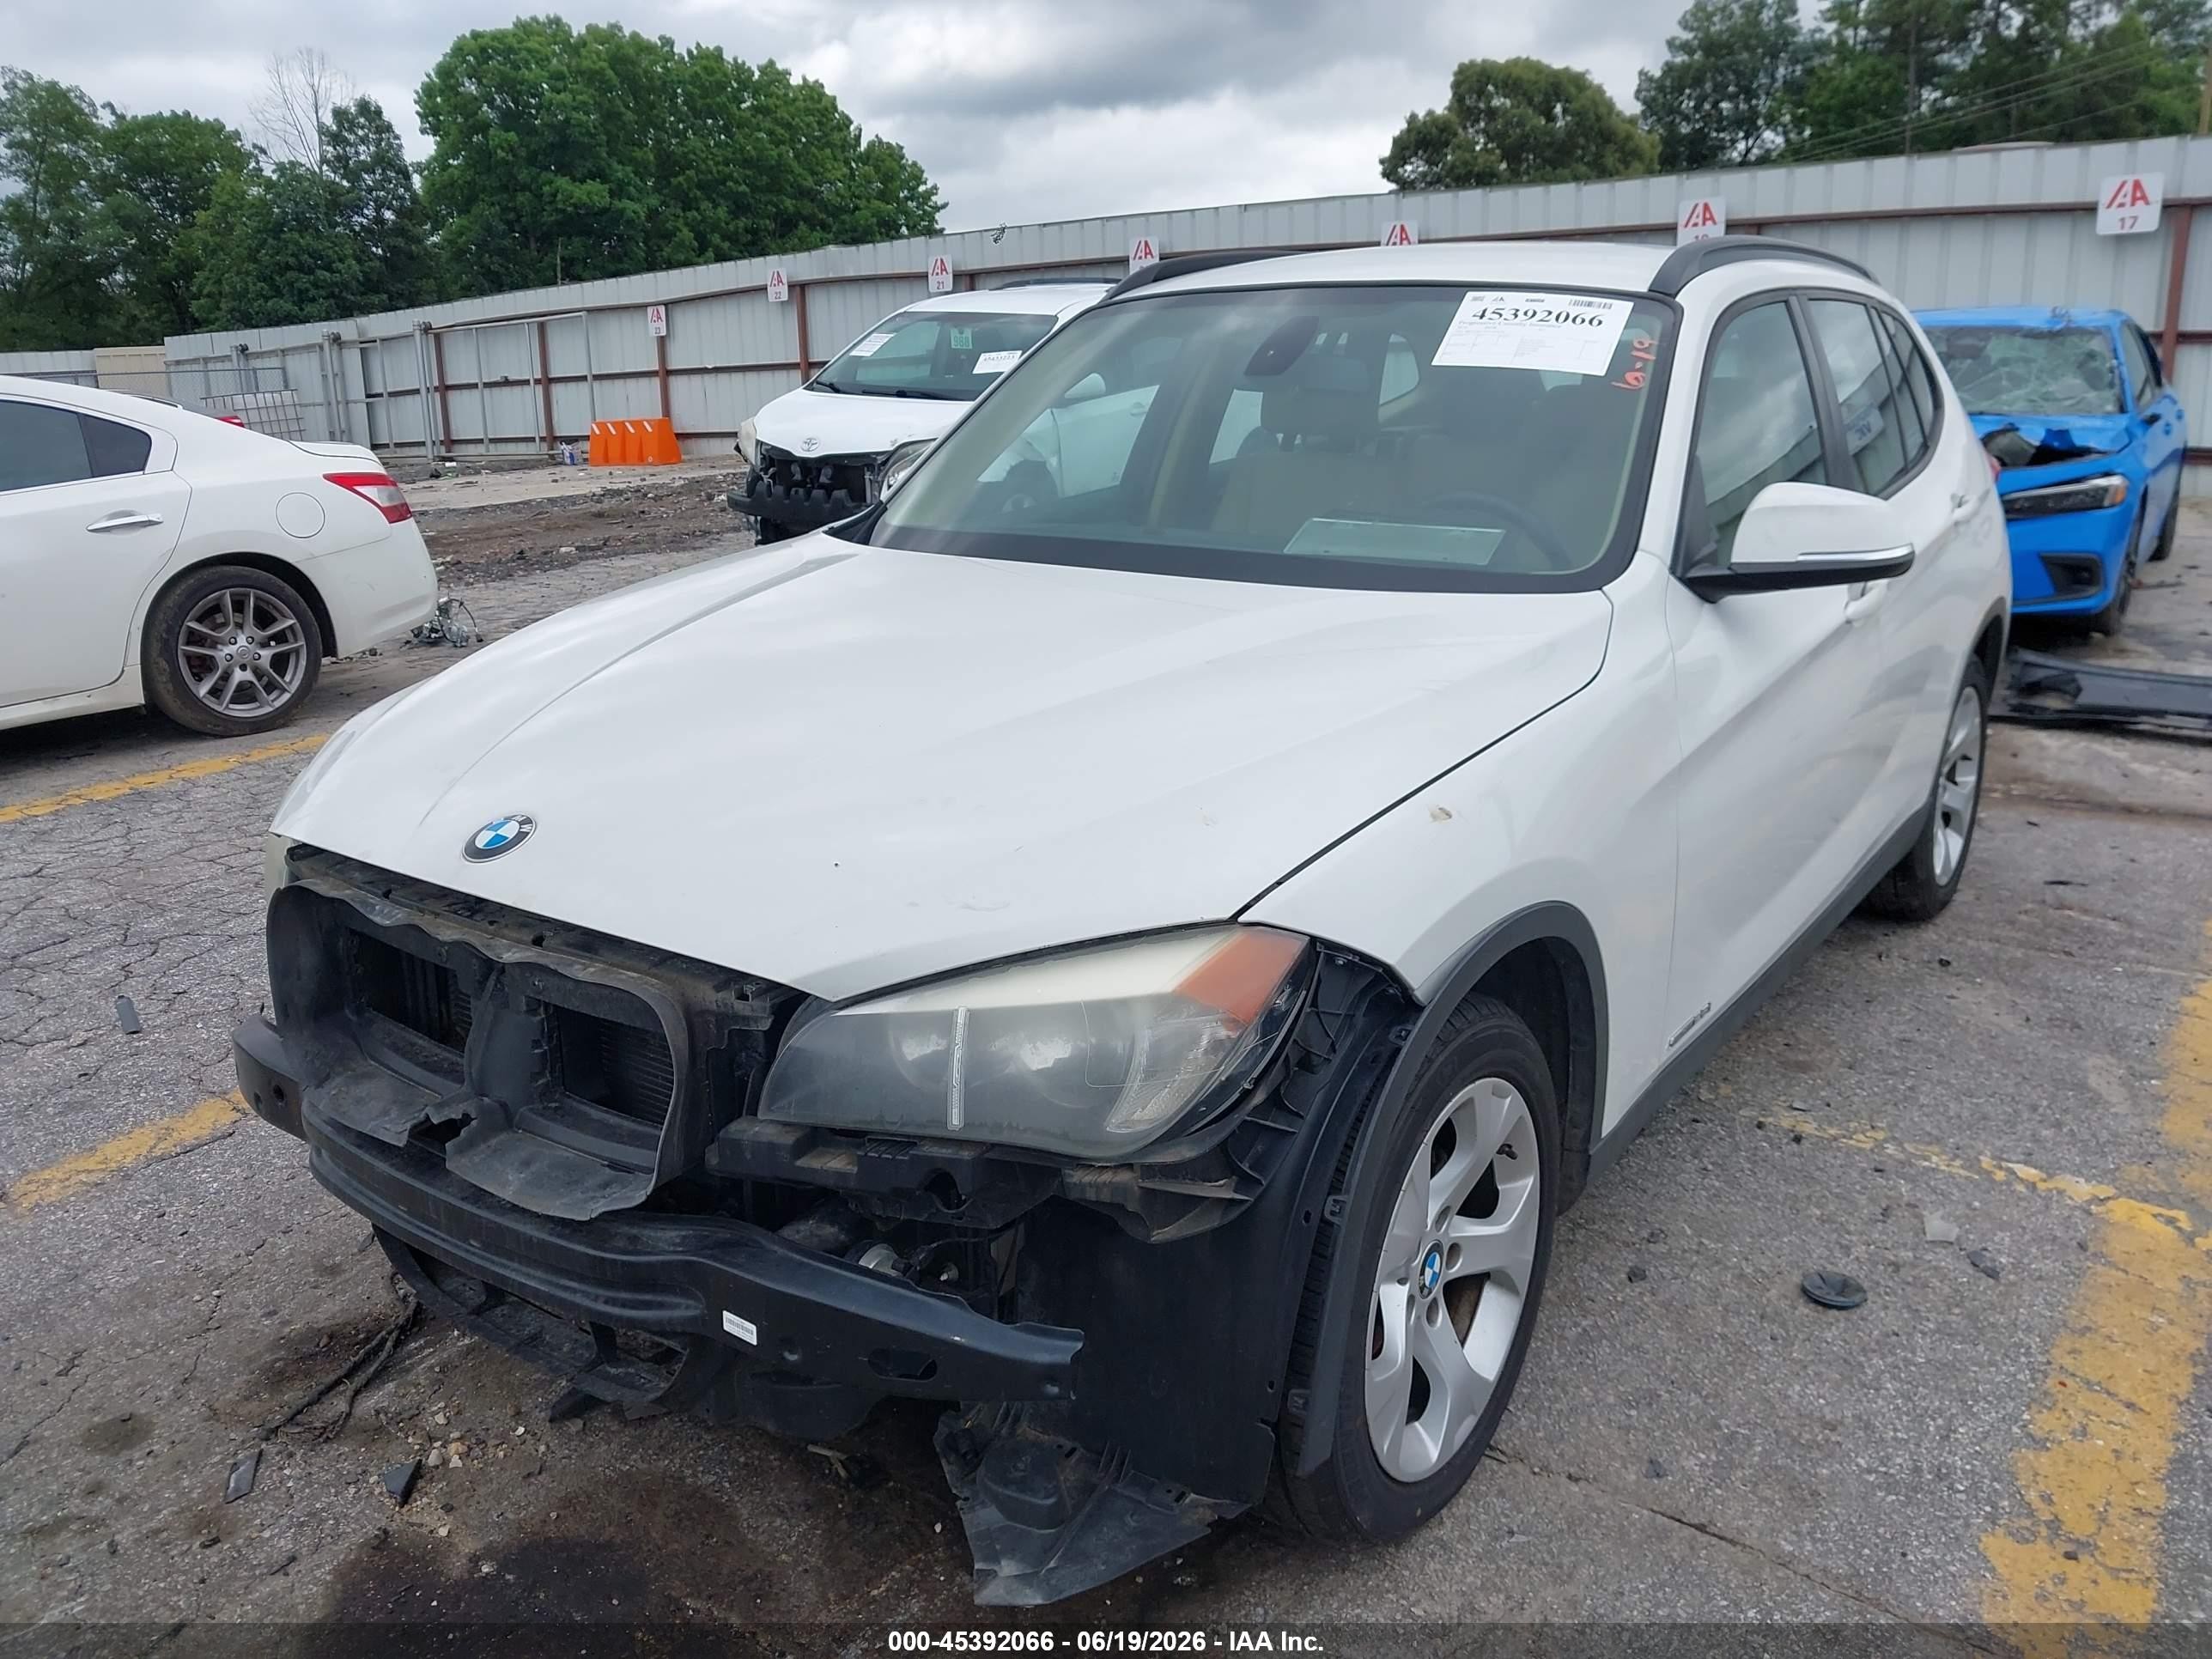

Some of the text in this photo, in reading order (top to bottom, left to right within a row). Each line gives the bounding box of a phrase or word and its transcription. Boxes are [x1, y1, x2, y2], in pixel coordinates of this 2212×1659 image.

[2118, 215, 2139, 230] 17
[936, 281, 945, 290] 21
[775, 291, 782, 300] 22
[1472, 307, 1605, 328] 45392066
